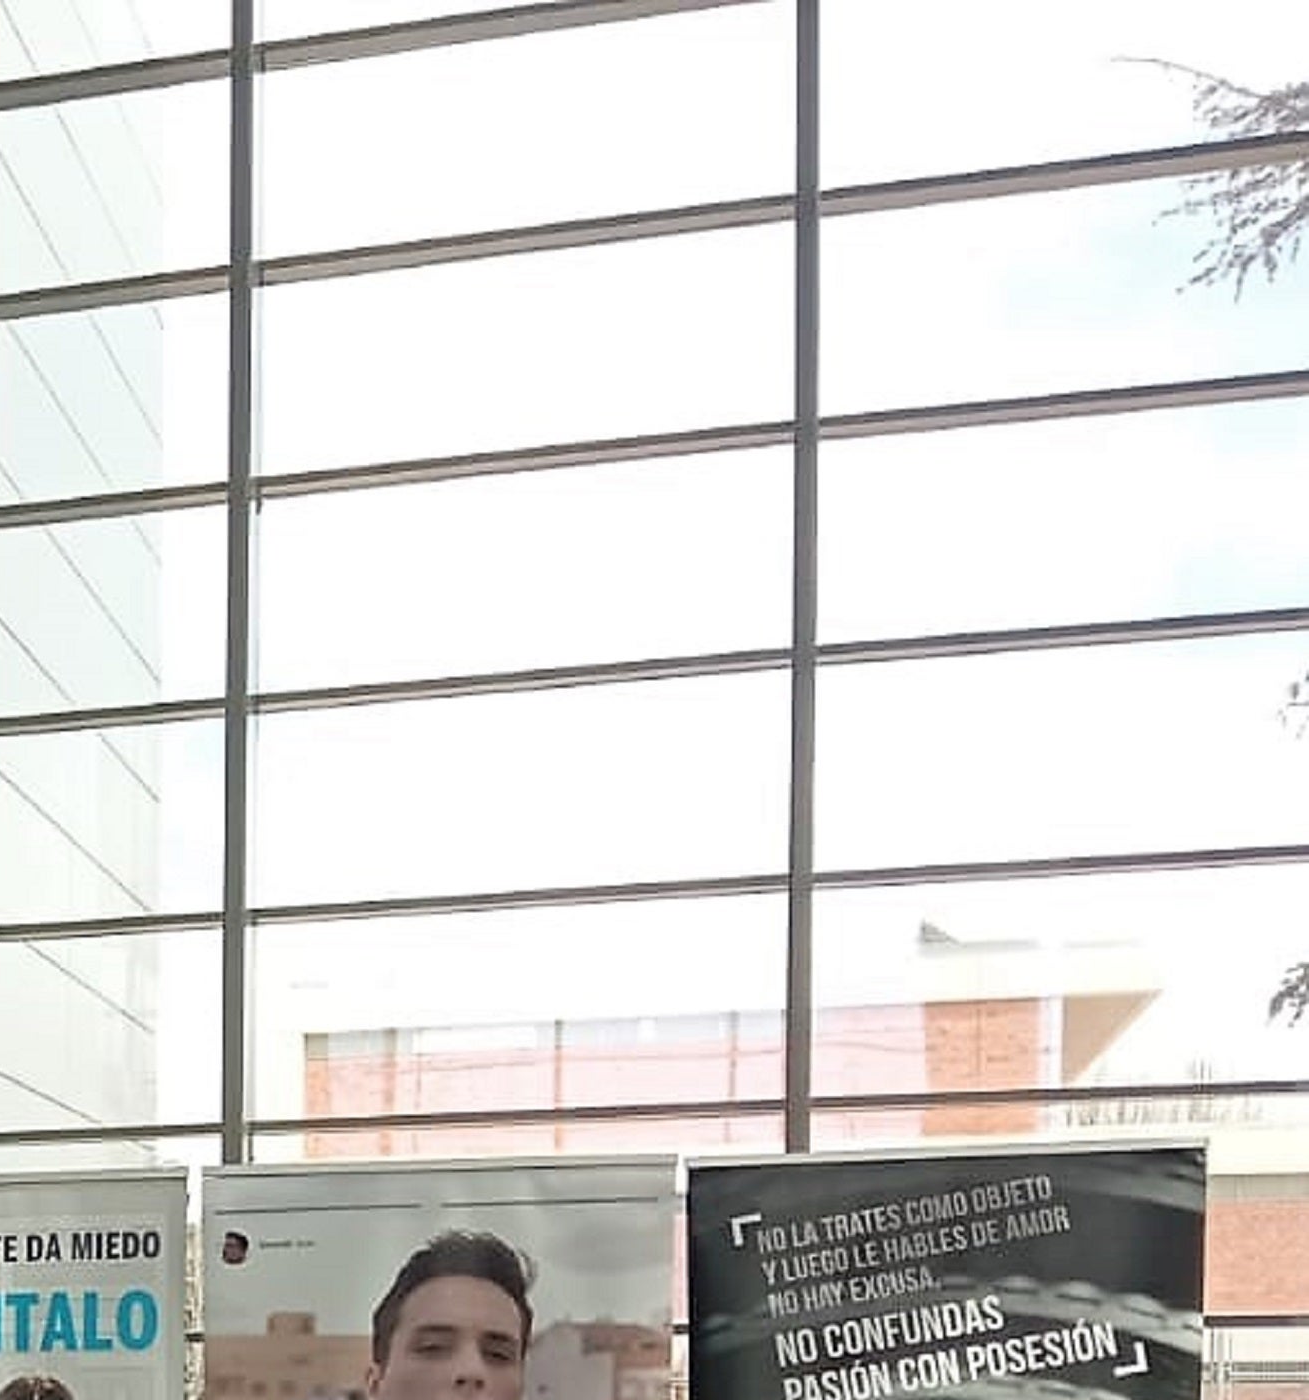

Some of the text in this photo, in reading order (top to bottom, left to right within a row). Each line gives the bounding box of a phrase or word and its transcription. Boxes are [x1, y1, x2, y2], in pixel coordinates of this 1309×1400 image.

[26, 1233, 61, 1263] DA
[71, 1230, 162, 1261] MIEDO
[758, 1174, 1053, 1254] NO LA TRATES COMO OBJETO
[761, 1205, 1071, 1286] Y LUEGO LE HABLES DE AMOR
[767, 1266, 942, 1319] NO HAY EXCUSA.
[775, 1295, 1005, 1368] NO CONFUNDAS
[897, 1348, 961, 1393] CON
[965, 1318, 1118, 1381] POSESIÓN
